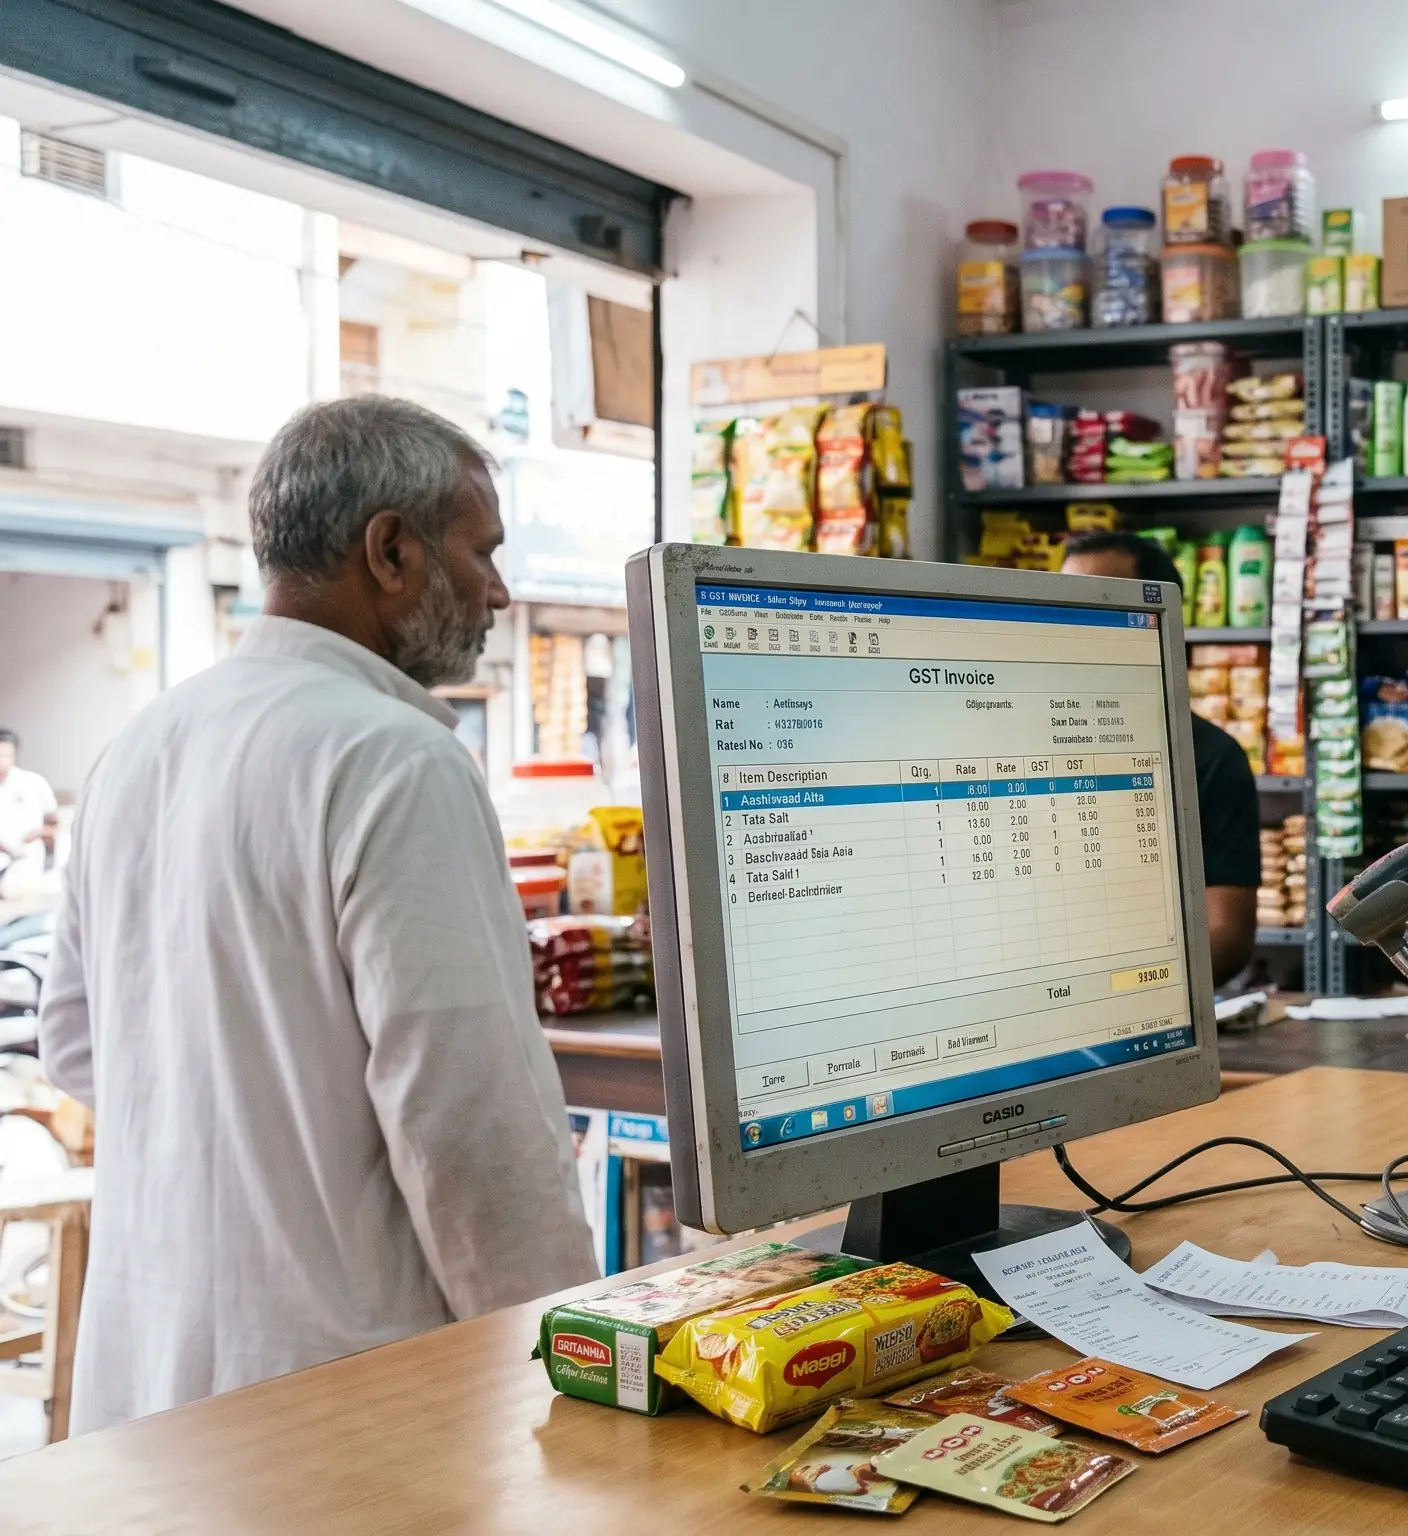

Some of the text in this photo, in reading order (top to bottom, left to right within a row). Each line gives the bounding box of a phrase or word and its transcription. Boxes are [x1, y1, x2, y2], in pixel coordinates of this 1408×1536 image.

[709, 591, 726, 601] GST
[909, 668, 995, 686] GST Invoice
[713, 698, 740, 709] Name
[715, 719, 734, 730] Rat
[749, 740, 763, 750] No
[776, 739, 793, 750] 036
[739, 771, 764, 784] Item
[956, 764, 976, 775] Rate
[996, 762, 1017, 773] Rate
[1132, 757, 1151, 768] Total
[724, 797, 729, 808] 1
[725, 815, 732, 827] 2
[742, 813, 765, 825] Tata
[769, 812, 789, 824] Salt
[1050, 797, 1056, 807] 0
[726, 835, 733, 846] 2
[1010, 815, 1028, 826] 2.00
[1051, 813, 1057, 823] 0
[728, 854, 734, 866] 3
[1012, 831, 1029, 843] 2.00
[729, 873, 736, 885] 4
[746, 871, 769, 883] Tata
[1013, 848, 1031, 860] 2.00
[1054, 845, 1059, 856] 0
[1084, 842, 1101, 853] 0.00
[731, 893, 737, 904] 0
[1055, 862, 1061, 873] 0
[1085, 858, 1102, 869] 0.00
[1047, 985, 1071, 999] Total
[982, 1104, 1025, 1125] CASIO
[792, 1347, 848, 1378] Maggi
